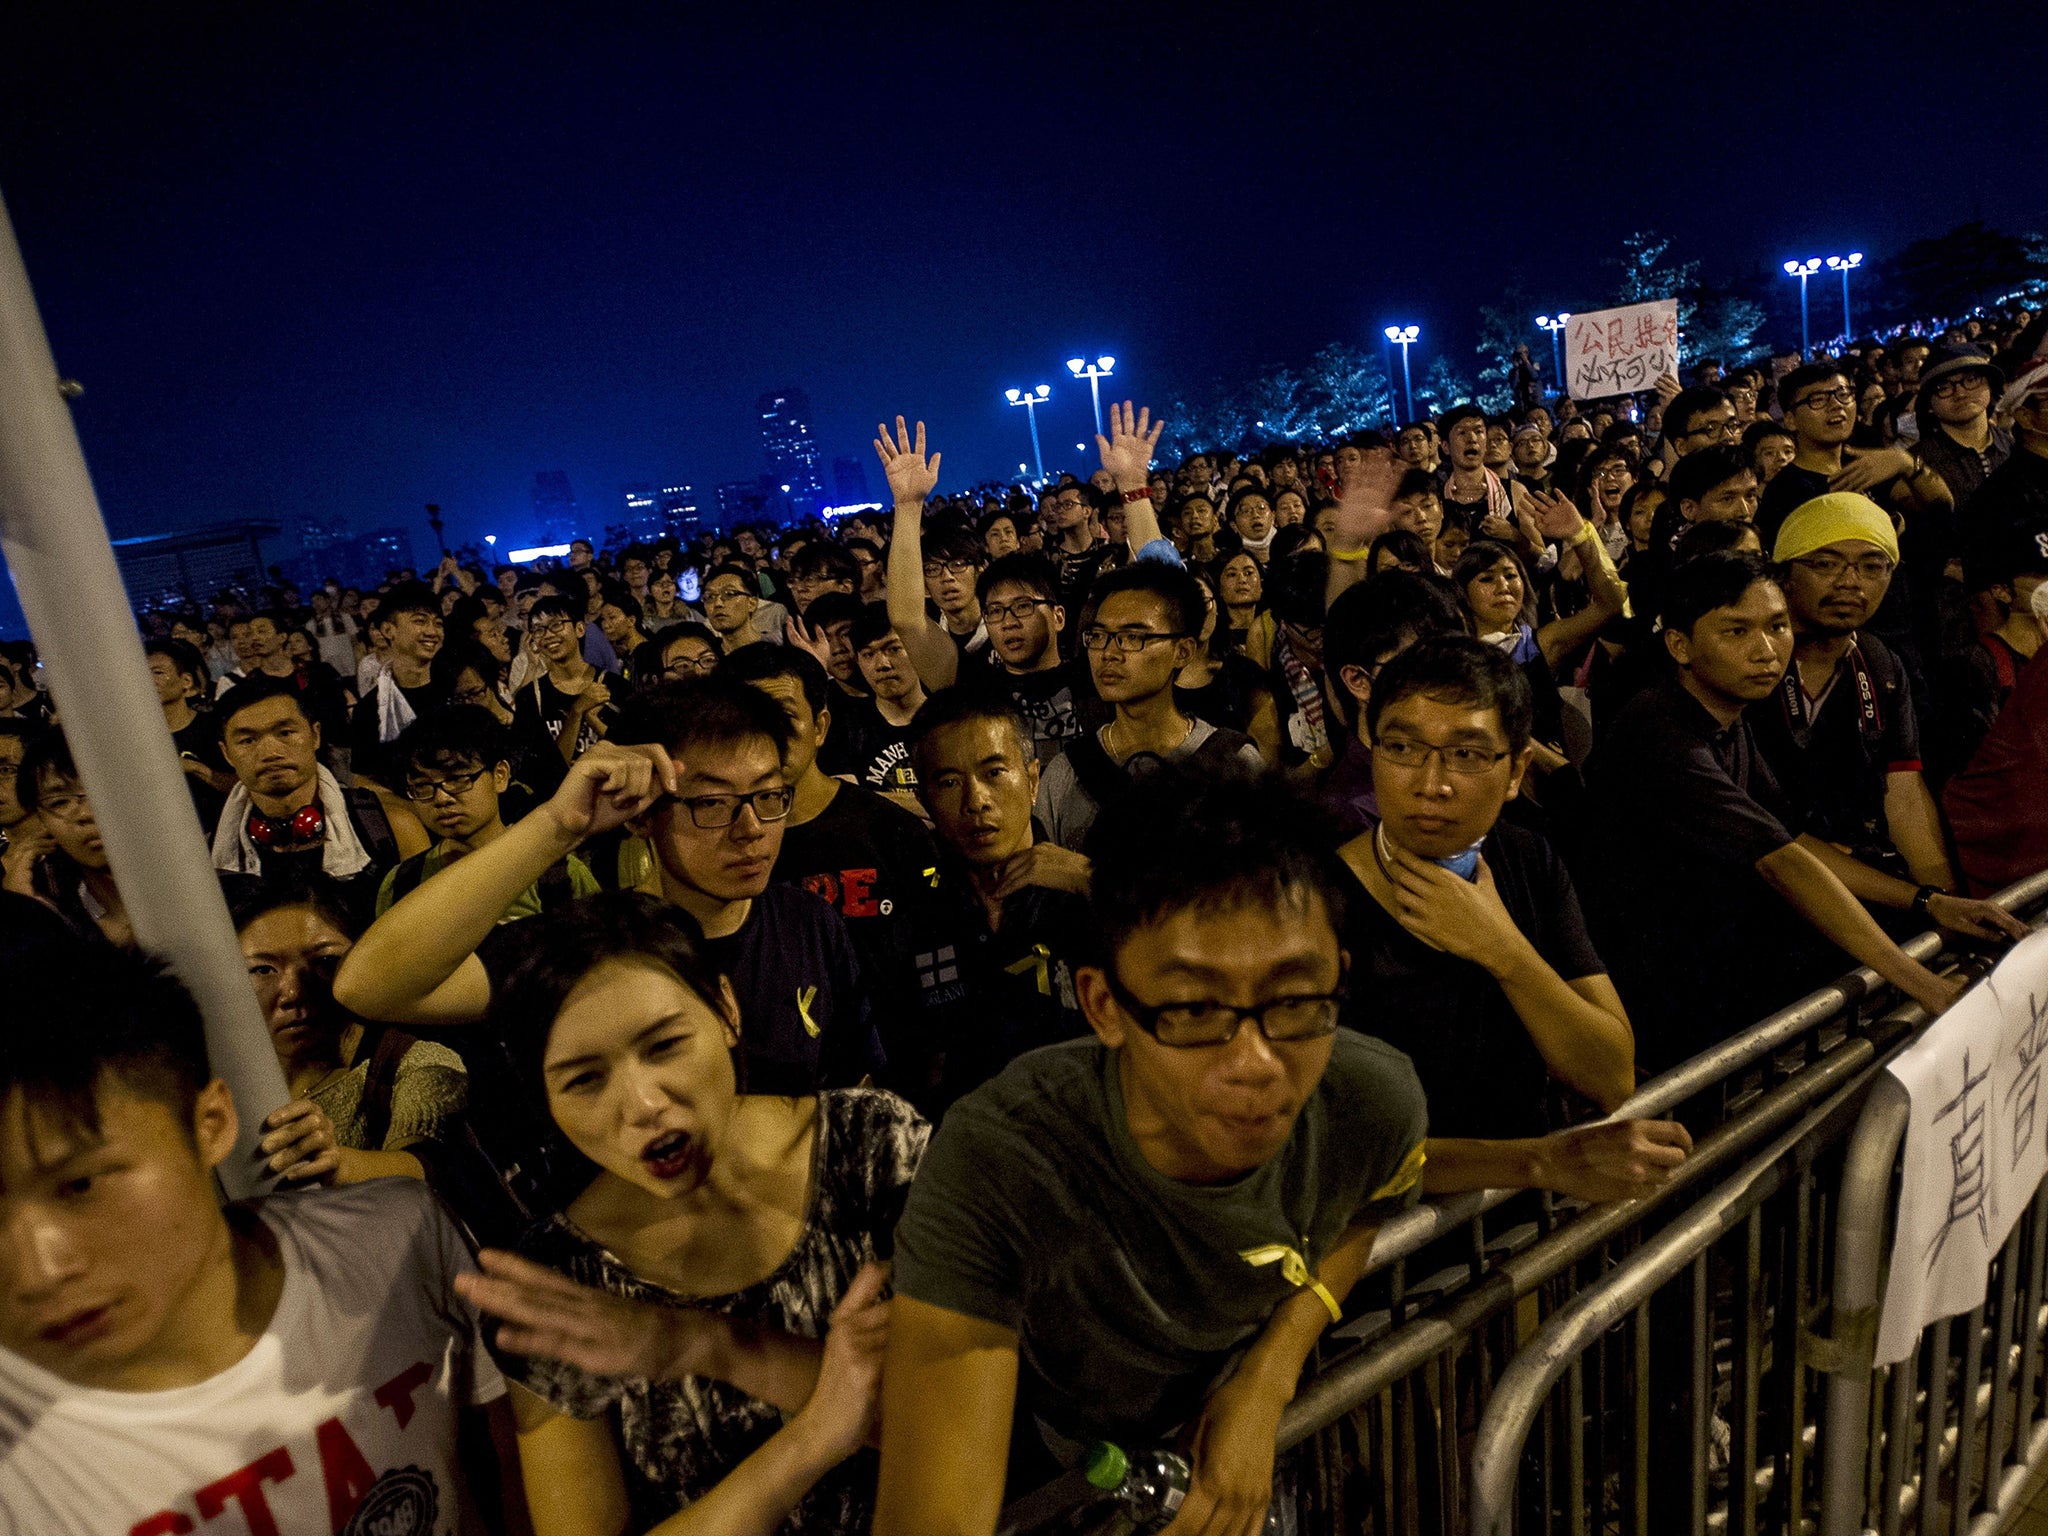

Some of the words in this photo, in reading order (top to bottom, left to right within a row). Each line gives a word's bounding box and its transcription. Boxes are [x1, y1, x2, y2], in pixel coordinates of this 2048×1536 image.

[1784, 674, 1800, 716] Canon
[1857, 670, 1873, 702] EOS
[1864, 702, 1875, 719] 7D
